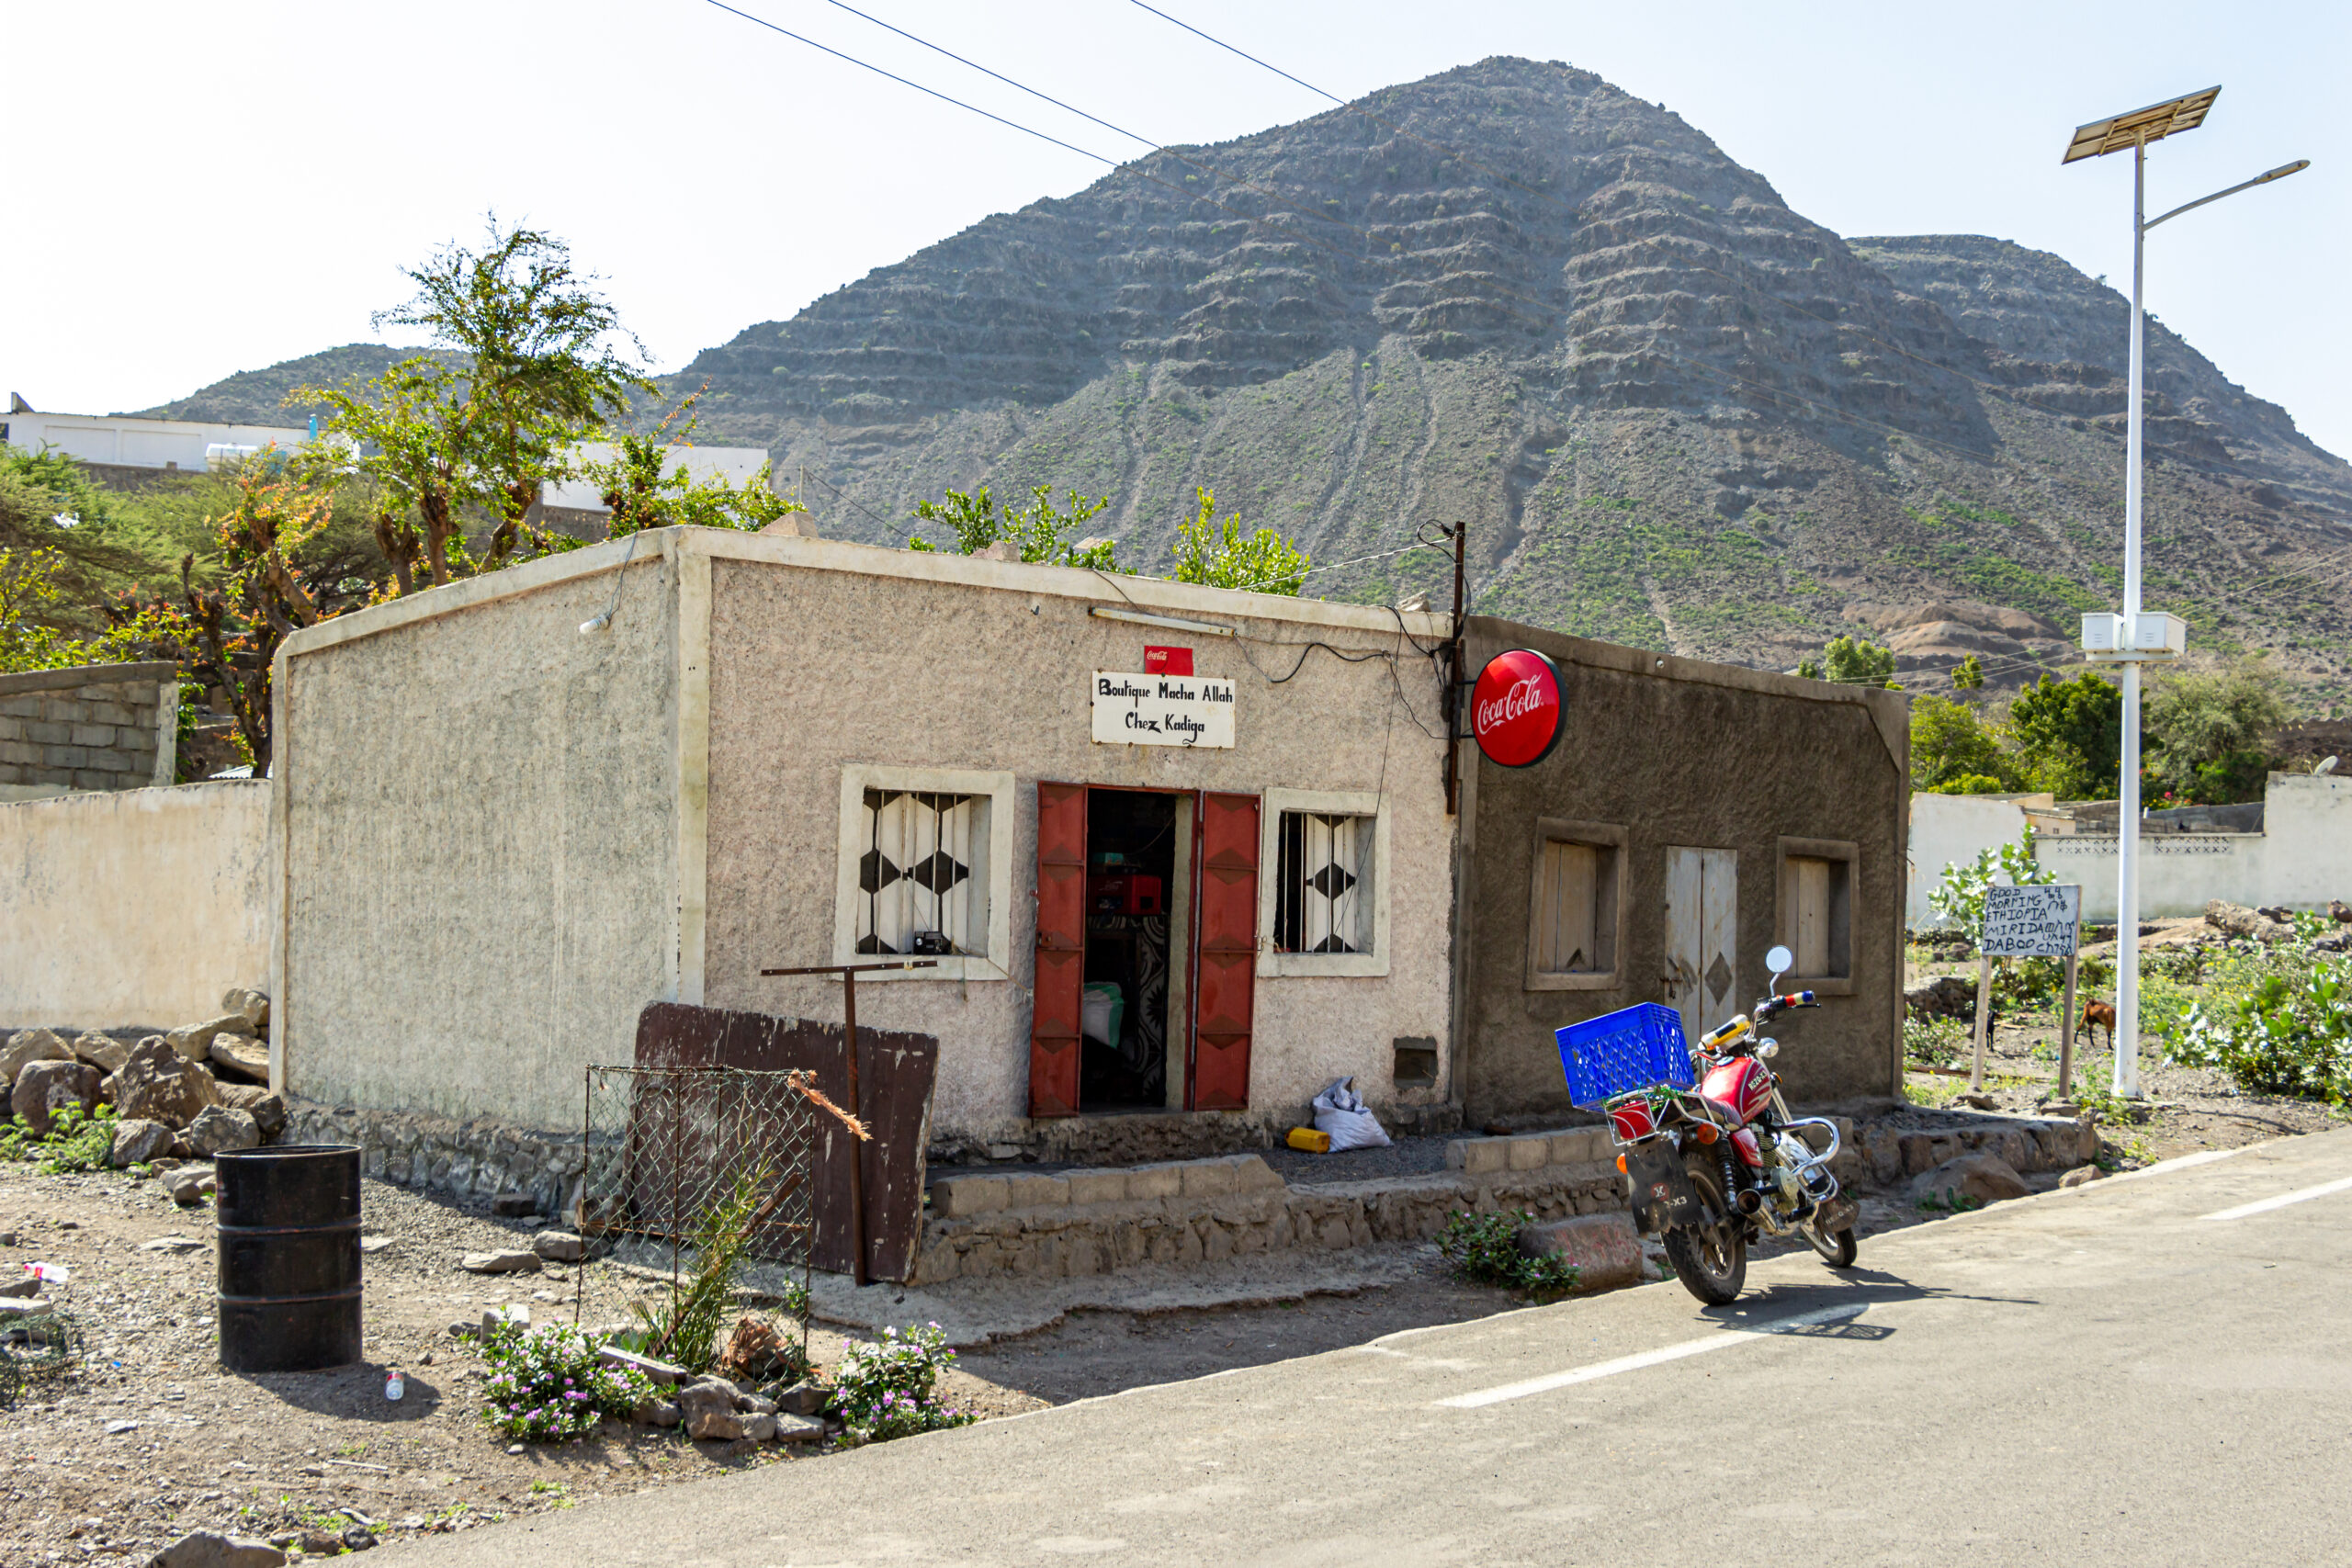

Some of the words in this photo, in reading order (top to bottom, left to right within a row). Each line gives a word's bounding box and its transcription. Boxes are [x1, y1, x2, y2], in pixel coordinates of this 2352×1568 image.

[1098, 678, 1151, 708] Boutique
[1158, 682, 1195, 701] Macha
[1202, 684, 1233, 703] Allah
[1477, 673, 1543, 735] Coca-Cola
[1125, 711, 1162, 734] Chez
[1165, 714, 1205, 745] Kadiga
[1985, 908, 2048, 922] ETHIOPIA
[1986, 895, 2042, 910] MORNING
